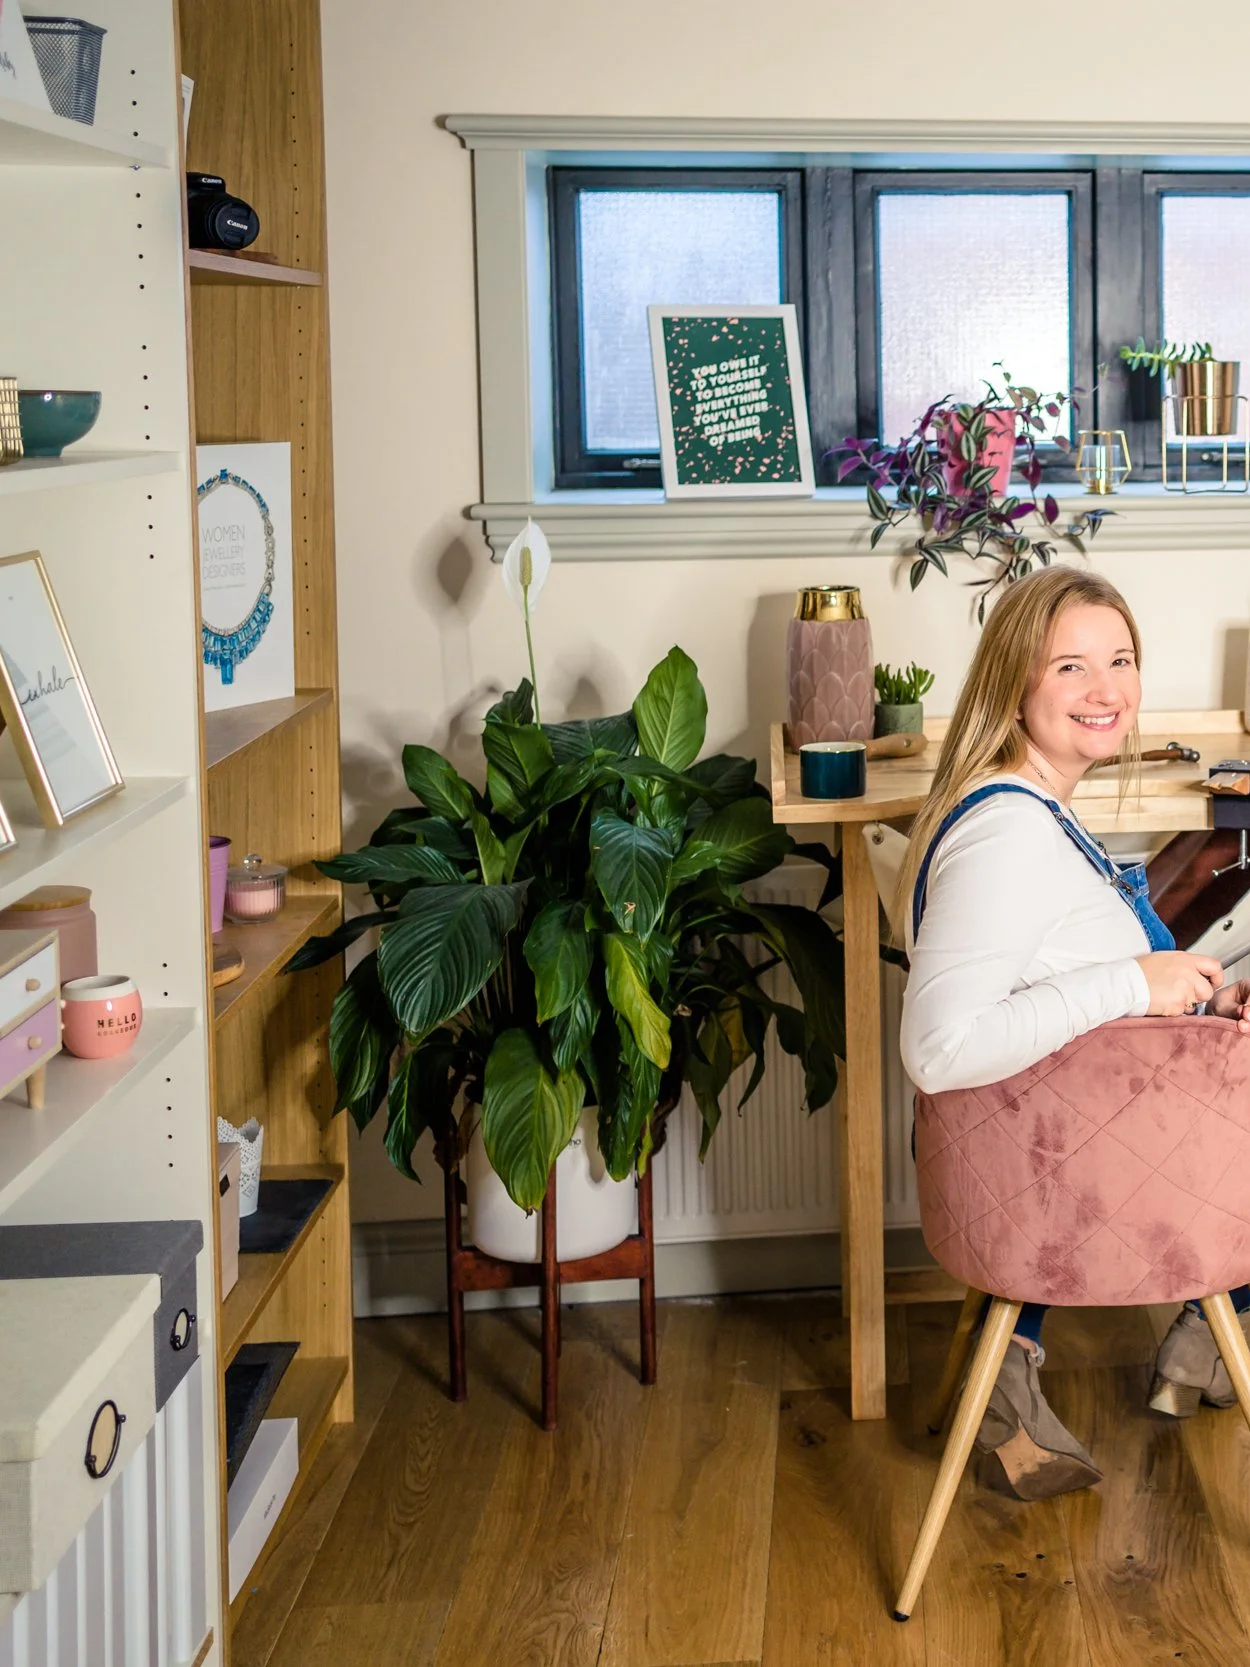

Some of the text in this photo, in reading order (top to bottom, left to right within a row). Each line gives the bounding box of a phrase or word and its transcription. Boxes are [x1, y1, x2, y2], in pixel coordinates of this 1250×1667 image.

[226, 219, 248, 230] Canon
[692, 354, 760, 379] YOU OWE IT
[690, 365, 768, 391] TO YOURSELF
[696, 378, 762, 402] TO BECOME
[696, 389, 768, 415] EVERYTHING
[693, 401, 769, 427] YOU'VE EVER
[704, 415, 760, 436] DREAMED
[708, 427, 761, 447] OF BEING
[202, 524, 245, 543] WOMEN
[203, 561, 246, 580] DESIGNERS
[97, 1013, 136, 1028] HELLO
